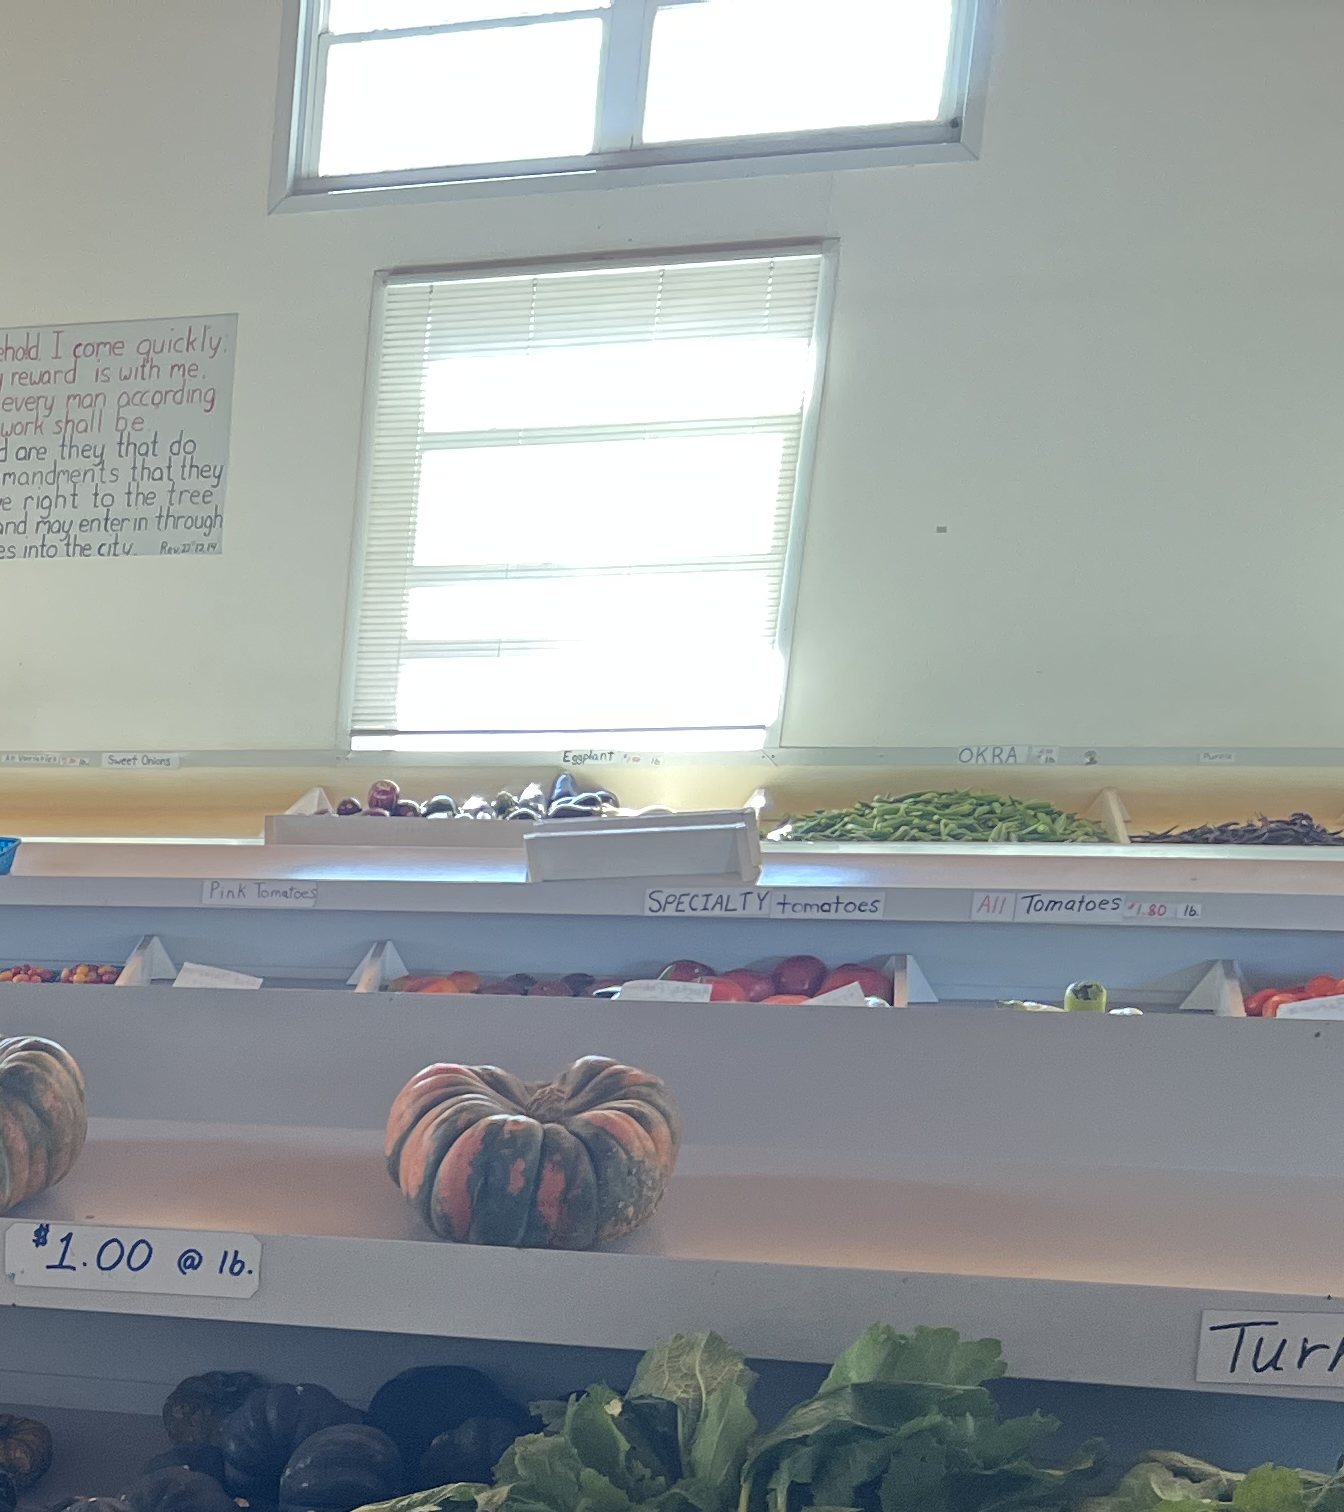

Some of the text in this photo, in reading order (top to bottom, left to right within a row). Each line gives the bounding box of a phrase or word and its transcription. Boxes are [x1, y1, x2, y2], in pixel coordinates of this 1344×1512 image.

[51, 330, 64, 360] I
[73, 340, 125, 358] come
[11, 357, 77, 386] reward
[95, 359, 110, 383] is
[119, 357, 160, 381] with
[2, 395, 54, 418] every
[66, 392, 106, 409] man
[117, 379, 216, 413] according
[0, 409, 43, 438] work
[53, 408, 102, 436] shall
[15, 446, 47, 461] are
[60, 432, 105, 466] they
[117, 431, 158, 458] that
[169, 430, 197, 455] do
[131, 456, 174, 482] that
[180, 454, 224, 488] they
[24, 482, 78, 519] right
[92, 483, 115, 508] to
[124, 481, 157, 507] the
[168, 481, 213, 506] tree
[35, 519, 73, 542] may
[155, 504, 224, 537] through
[24, 533, 58, 558] into
[65, 534, 92, 557] the
[108, 755, 171, 766] Sweet Onions
[563, 750, 614, 765] Eggplant
[958, 747, 1018, 764] OKRA
[209, 881, 317, 899] Pink Tomatoes
[648, 890, 880, 914] SPECIALTY tomatoes
[977, 895, 1005, 914] All
[1021, 894, 1122, 914] Tomatoes
[32, 1223, 253, 1276] $1.00 @ lb.
